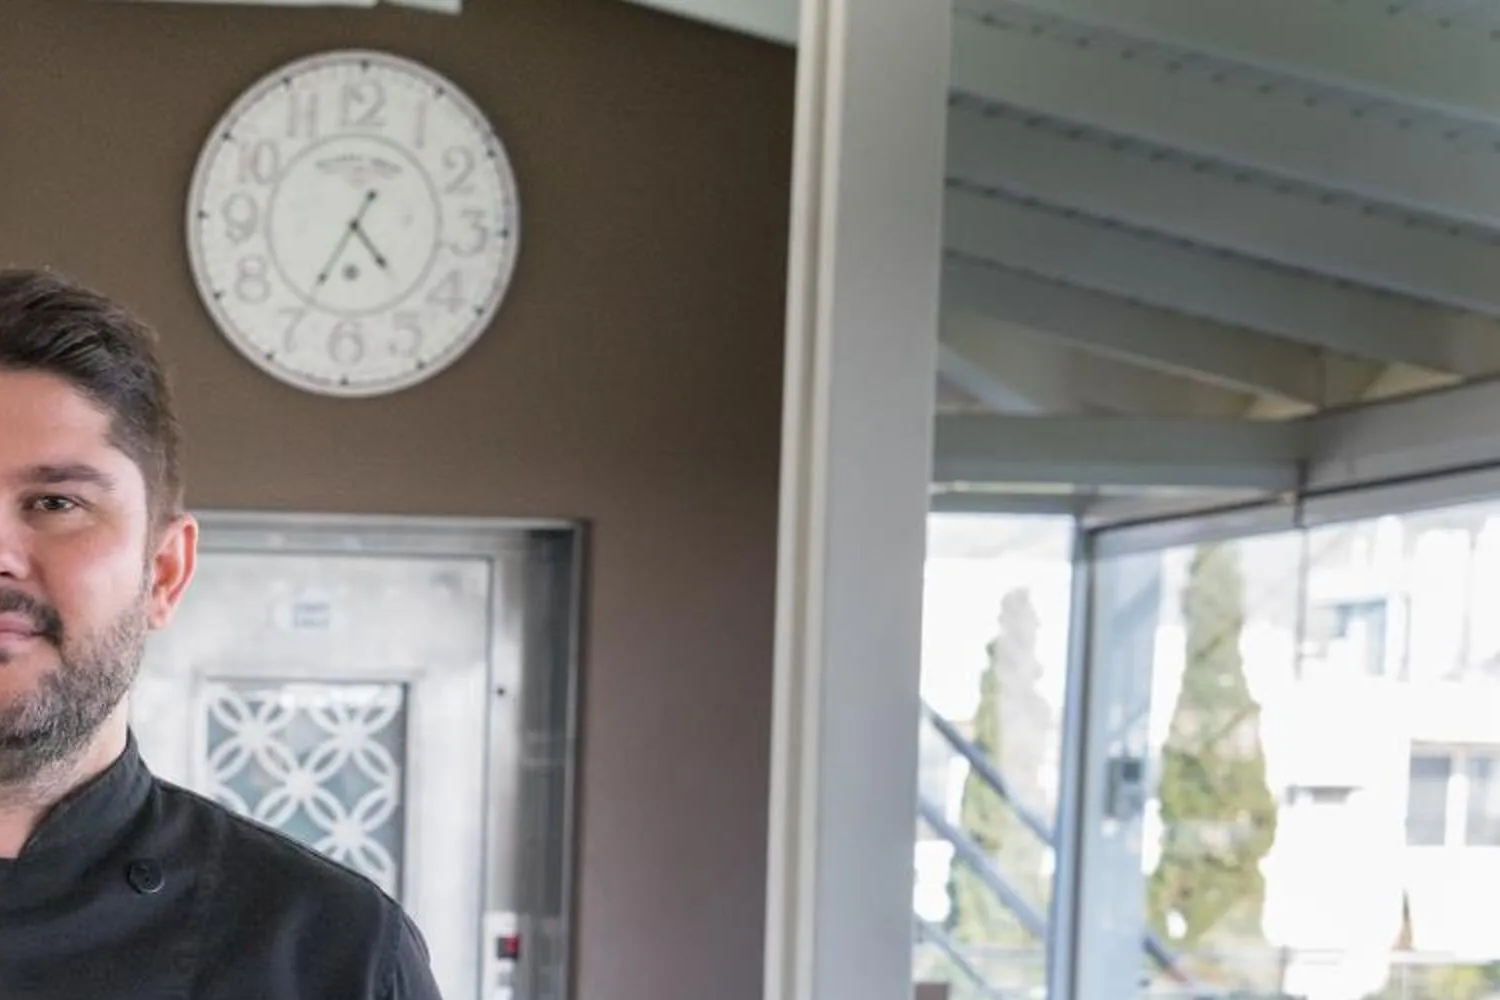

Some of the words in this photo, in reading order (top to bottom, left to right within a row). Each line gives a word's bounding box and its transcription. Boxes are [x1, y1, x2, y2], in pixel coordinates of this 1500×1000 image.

[286, 89, 319, 140] 11
[339, 79, 387, 128] 12
[414, 100, 427, 149] 1
[237, 139, 280, 185] 10
[442, 145, 476, 195] 2
[221, 192, 258, 244] 9
[449, 208, 489, 258] 3
[233, 253, 271, 304] 8
[425, 268, 466, 314] 4
[277, 306, 308, 353] 7
[327, 318, 364, 367] 6
[388, 310, 424, 358] 5
